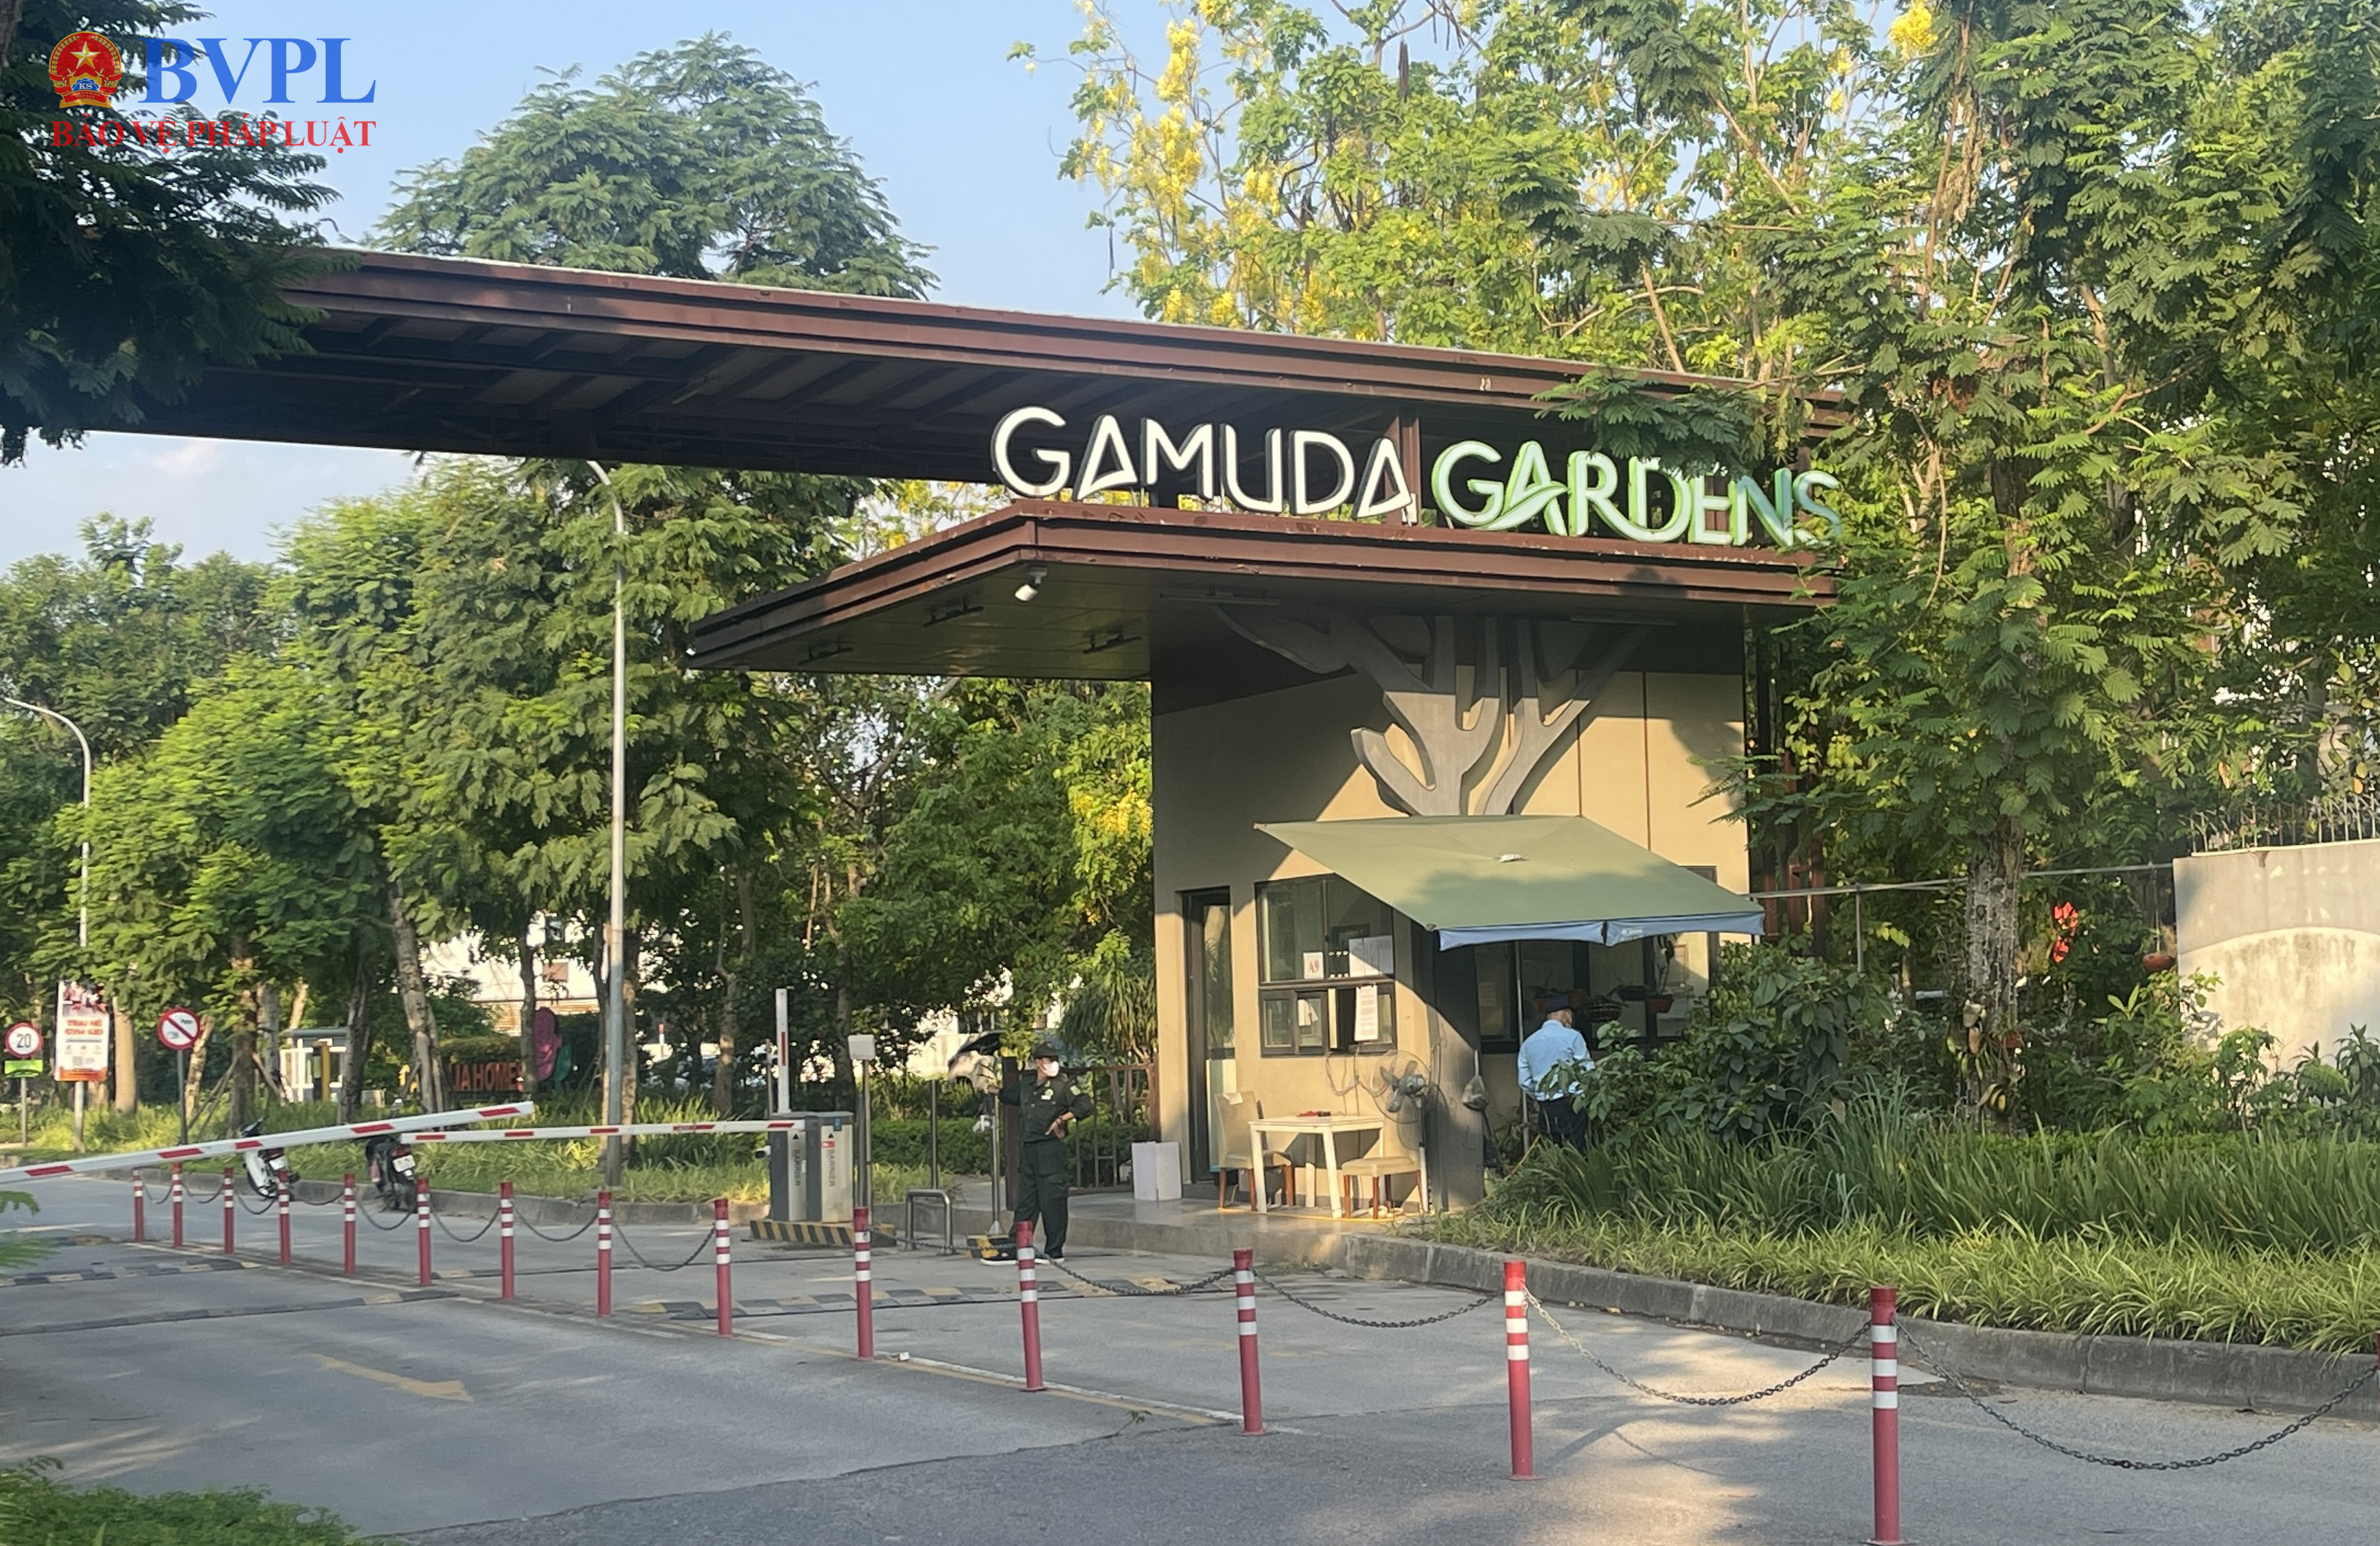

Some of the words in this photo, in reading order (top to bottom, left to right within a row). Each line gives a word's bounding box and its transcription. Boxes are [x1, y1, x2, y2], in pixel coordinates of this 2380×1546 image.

[991, 406, 1415, 520] GAMUDA
[1431, 439, 1843, 549] GARDENS
[17, 1033, 31, 1048] 20
[794, 1149, 802, 1187] BARRIER
